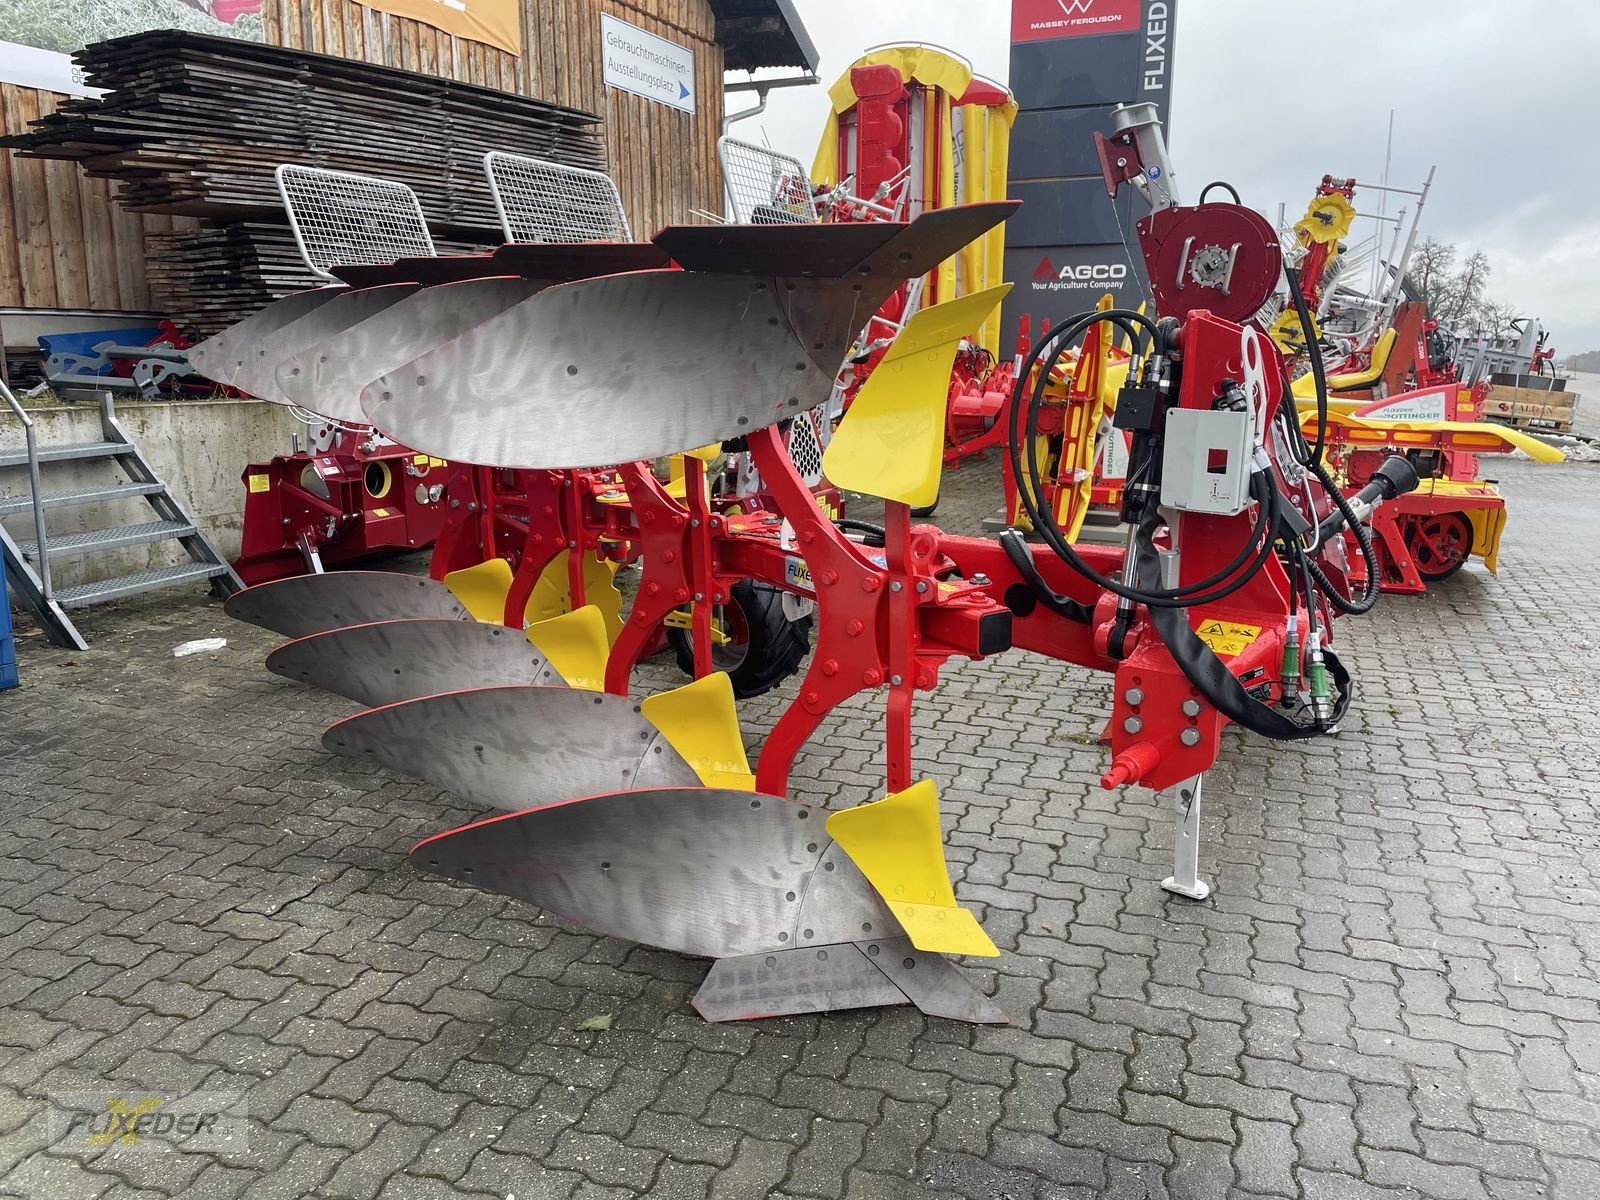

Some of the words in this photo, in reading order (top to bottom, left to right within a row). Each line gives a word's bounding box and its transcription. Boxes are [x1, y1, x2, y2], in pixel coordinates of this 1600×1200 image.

[1030, 19, 1069, 30] MASSEY
[1071, 14, 1122, 26] FERGUSON
[1144, 0, 1168, 91] FLIXED
[608, 57, 674, 93] Ausstellungsplatz
[1059, 264, 1127, 279] AGCO
[1031, 281, 1048, 290] Your
[1048, 281, 1088, 291] Agriculture
[1089, 280, 1124, 290] Company
[787, 564, 813, 582] FLIXE
